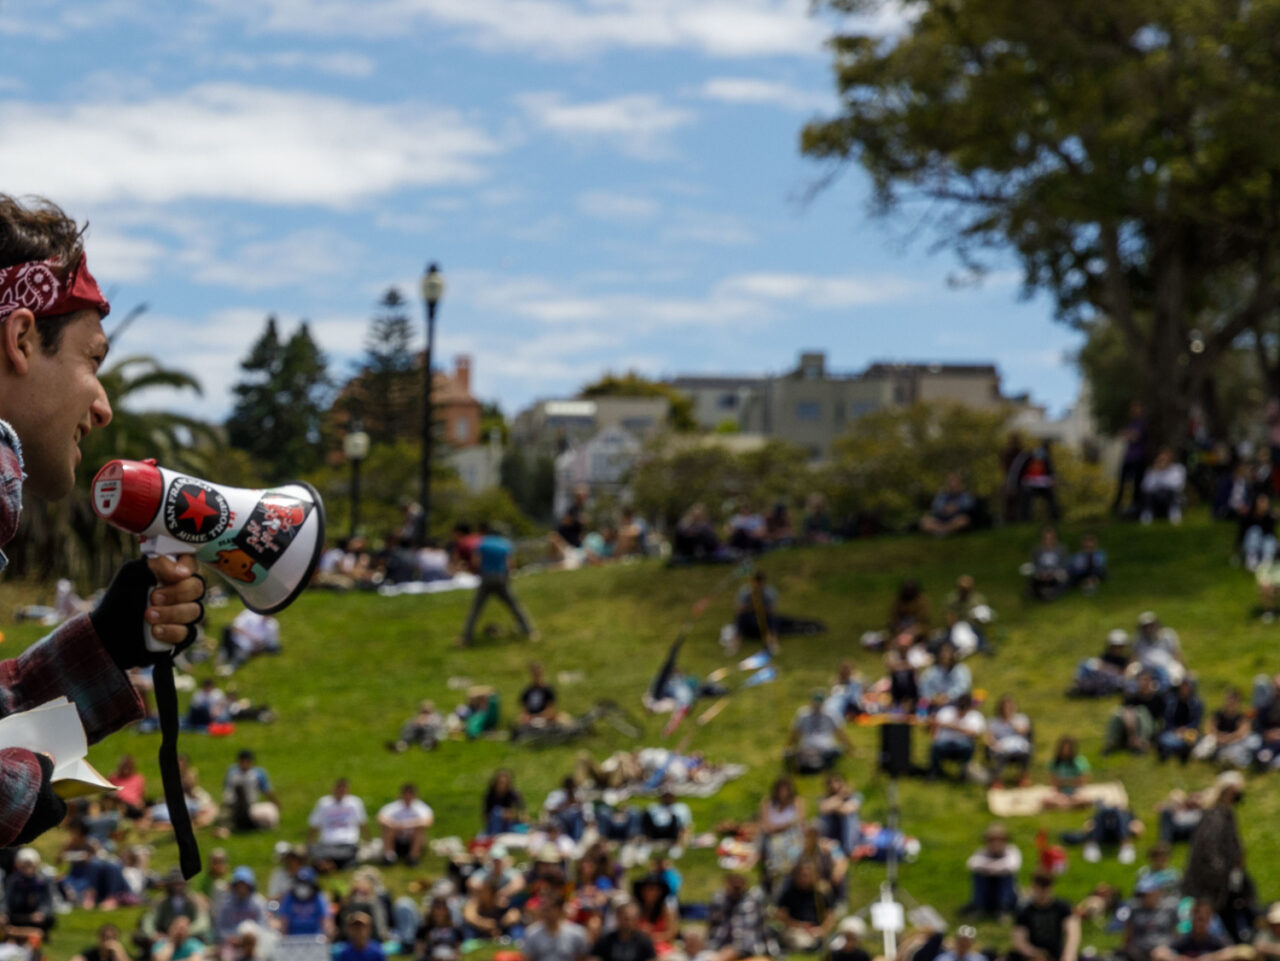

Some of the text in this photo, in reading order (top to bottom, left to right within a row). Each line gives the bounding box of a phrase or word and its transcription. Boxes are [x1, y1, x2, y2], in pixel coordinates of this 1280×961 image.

[167, 505, 178, 529] SAN
[178, 530, 208, 541] MIME
[209, 494, 228, 537] TROUPE
